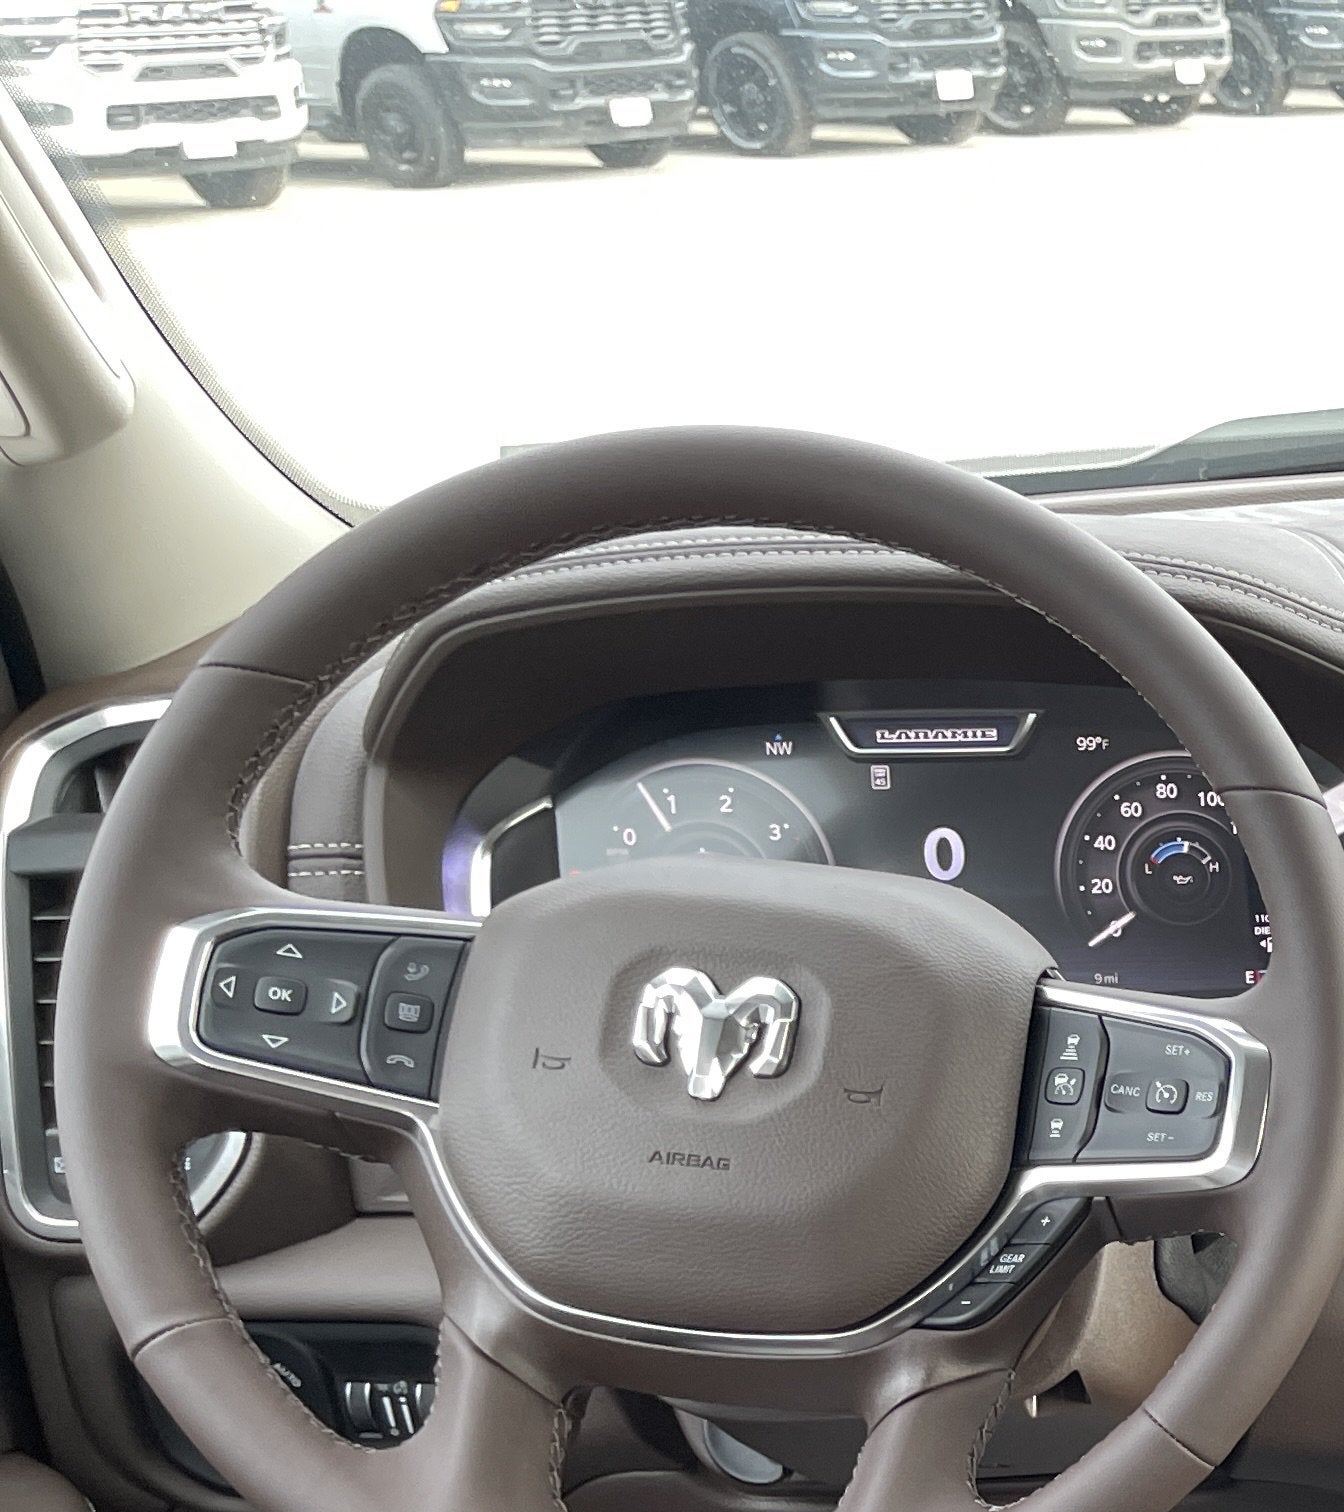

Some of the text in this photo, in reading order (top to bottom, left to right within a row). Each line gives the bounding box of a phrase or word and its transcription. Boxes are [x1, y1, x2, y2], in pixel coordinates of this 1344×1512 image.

[876, 728, 998, 743] LARAMIE
[765, 741, 793, 756] NW
[1156, 783, 1178, 798] 80
[666, 795, 677, 814] 1
[718, 795, 734, 813] 2
[1120, 802, 1142, 817] 60
[622, 828, 637, 846] 0
[769, 824, 782, 841] 3
[1093, 835, 1116, 850] 40
[923, 827, 965, 880] 0
[1145, 863, 1152, 875] L
[1209, 862, 1219, 874] H
[1091, 879, 1113, 894] 20
[1094, 972, 1119, 984] 9 mi
[1245, 971, 1255, 984] E
[268, 985, 292, 1002] OK
[1110, 1084, 1140, 1097] CANC
[1195, 1091, 1213, 1102] RES
[648, 1150, 731, 1171] AIRBAG
[1000, 1253, 1025, 1263] GEAR
[989, 1265, 1015, 1274] LIMIT
